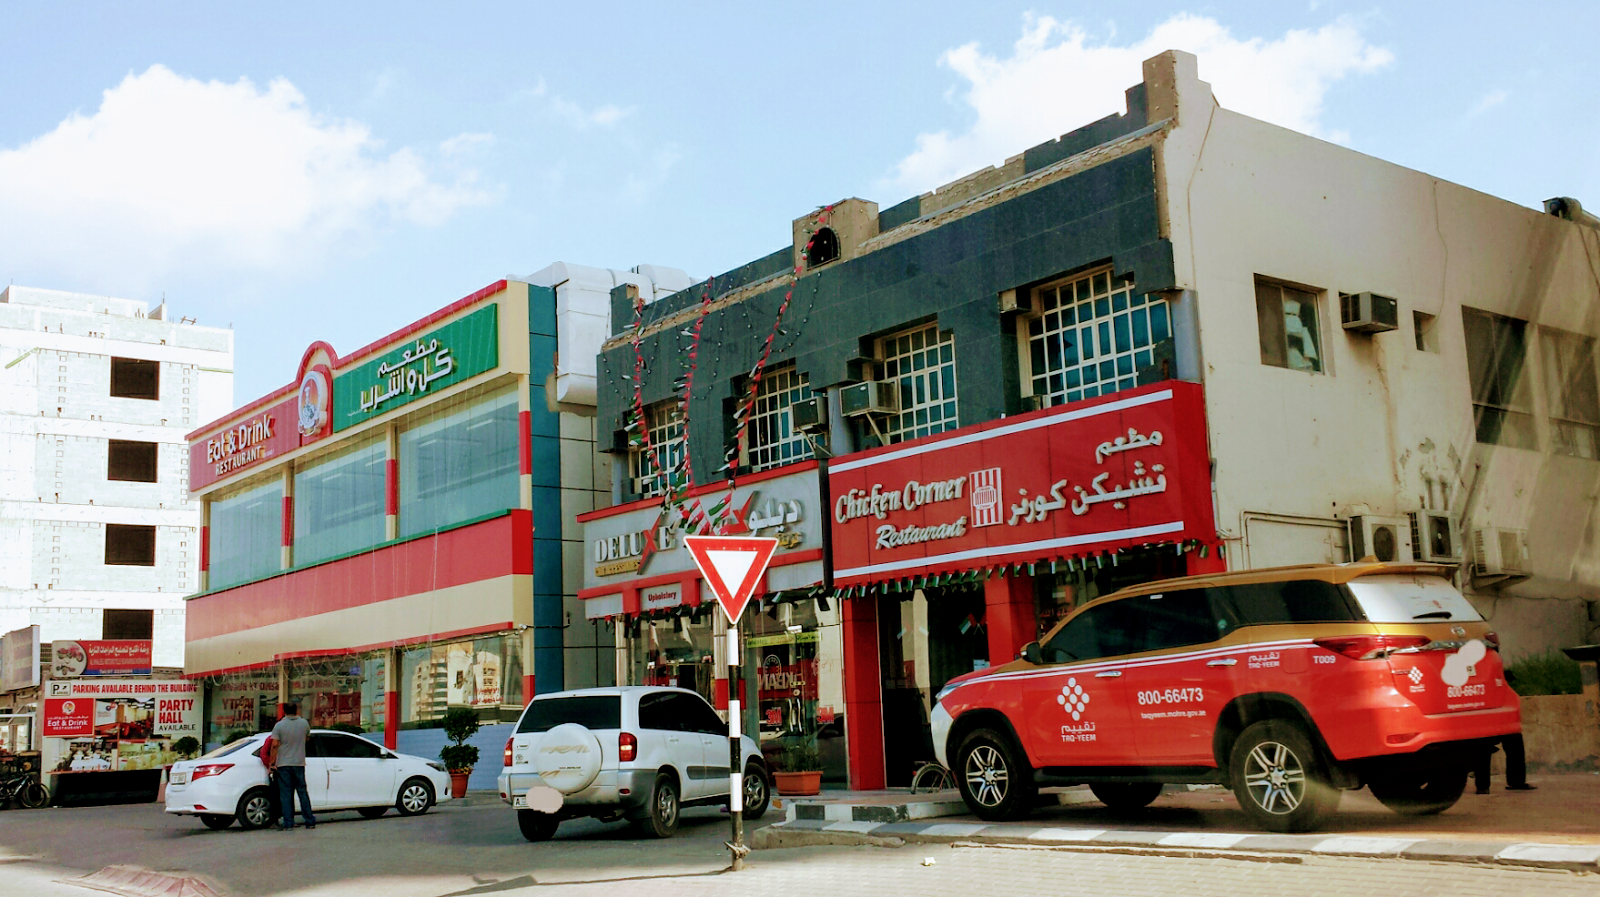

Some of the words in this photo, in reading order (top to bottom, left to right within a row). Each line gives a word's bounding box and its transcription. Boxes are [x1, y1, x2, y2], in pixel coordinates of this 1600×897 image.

[377, 338, 437, 378] مطعم
[207, 432, 226, 464] Eat
[229, 429, 237, 455] &
[239, 414, 272, 450] Drink
[1095, 427, 1163, 464] مطعم
[216, 445, 262, 476] RESTAURANT
[835, 483, 902, 524] Chicken
[903, 476, 967, 511] Corner
[1071, 460, 1167, 516] تشيكن
[1007, 478, 1068, 526] كورنر
[595, 512, 676, 575] DELUXE
[875, 515, 968, 550] Restaurant
[648, 591, 677, 602] Upholstery
[1312, 655, 1336, 664] T009
[72, 684, 100, 693] PARKING
[101, 684, 133, 693] AVAILABLE
[134, 684, 156, 693] BEHIND
[158, 684, 169, 692] THE
[170, 683, 197, 693] BUILDING
[1137, 687, 1204, 706] 800-66473
[159, 699, 194, 711] PARTY
[47, 719, 60, 727] Eat
[158, 712, 183, 724] HALL
[1061, 721, 1096, 735] تقييم
[1061, 733, 1097, 742] TAQ-YEEM
